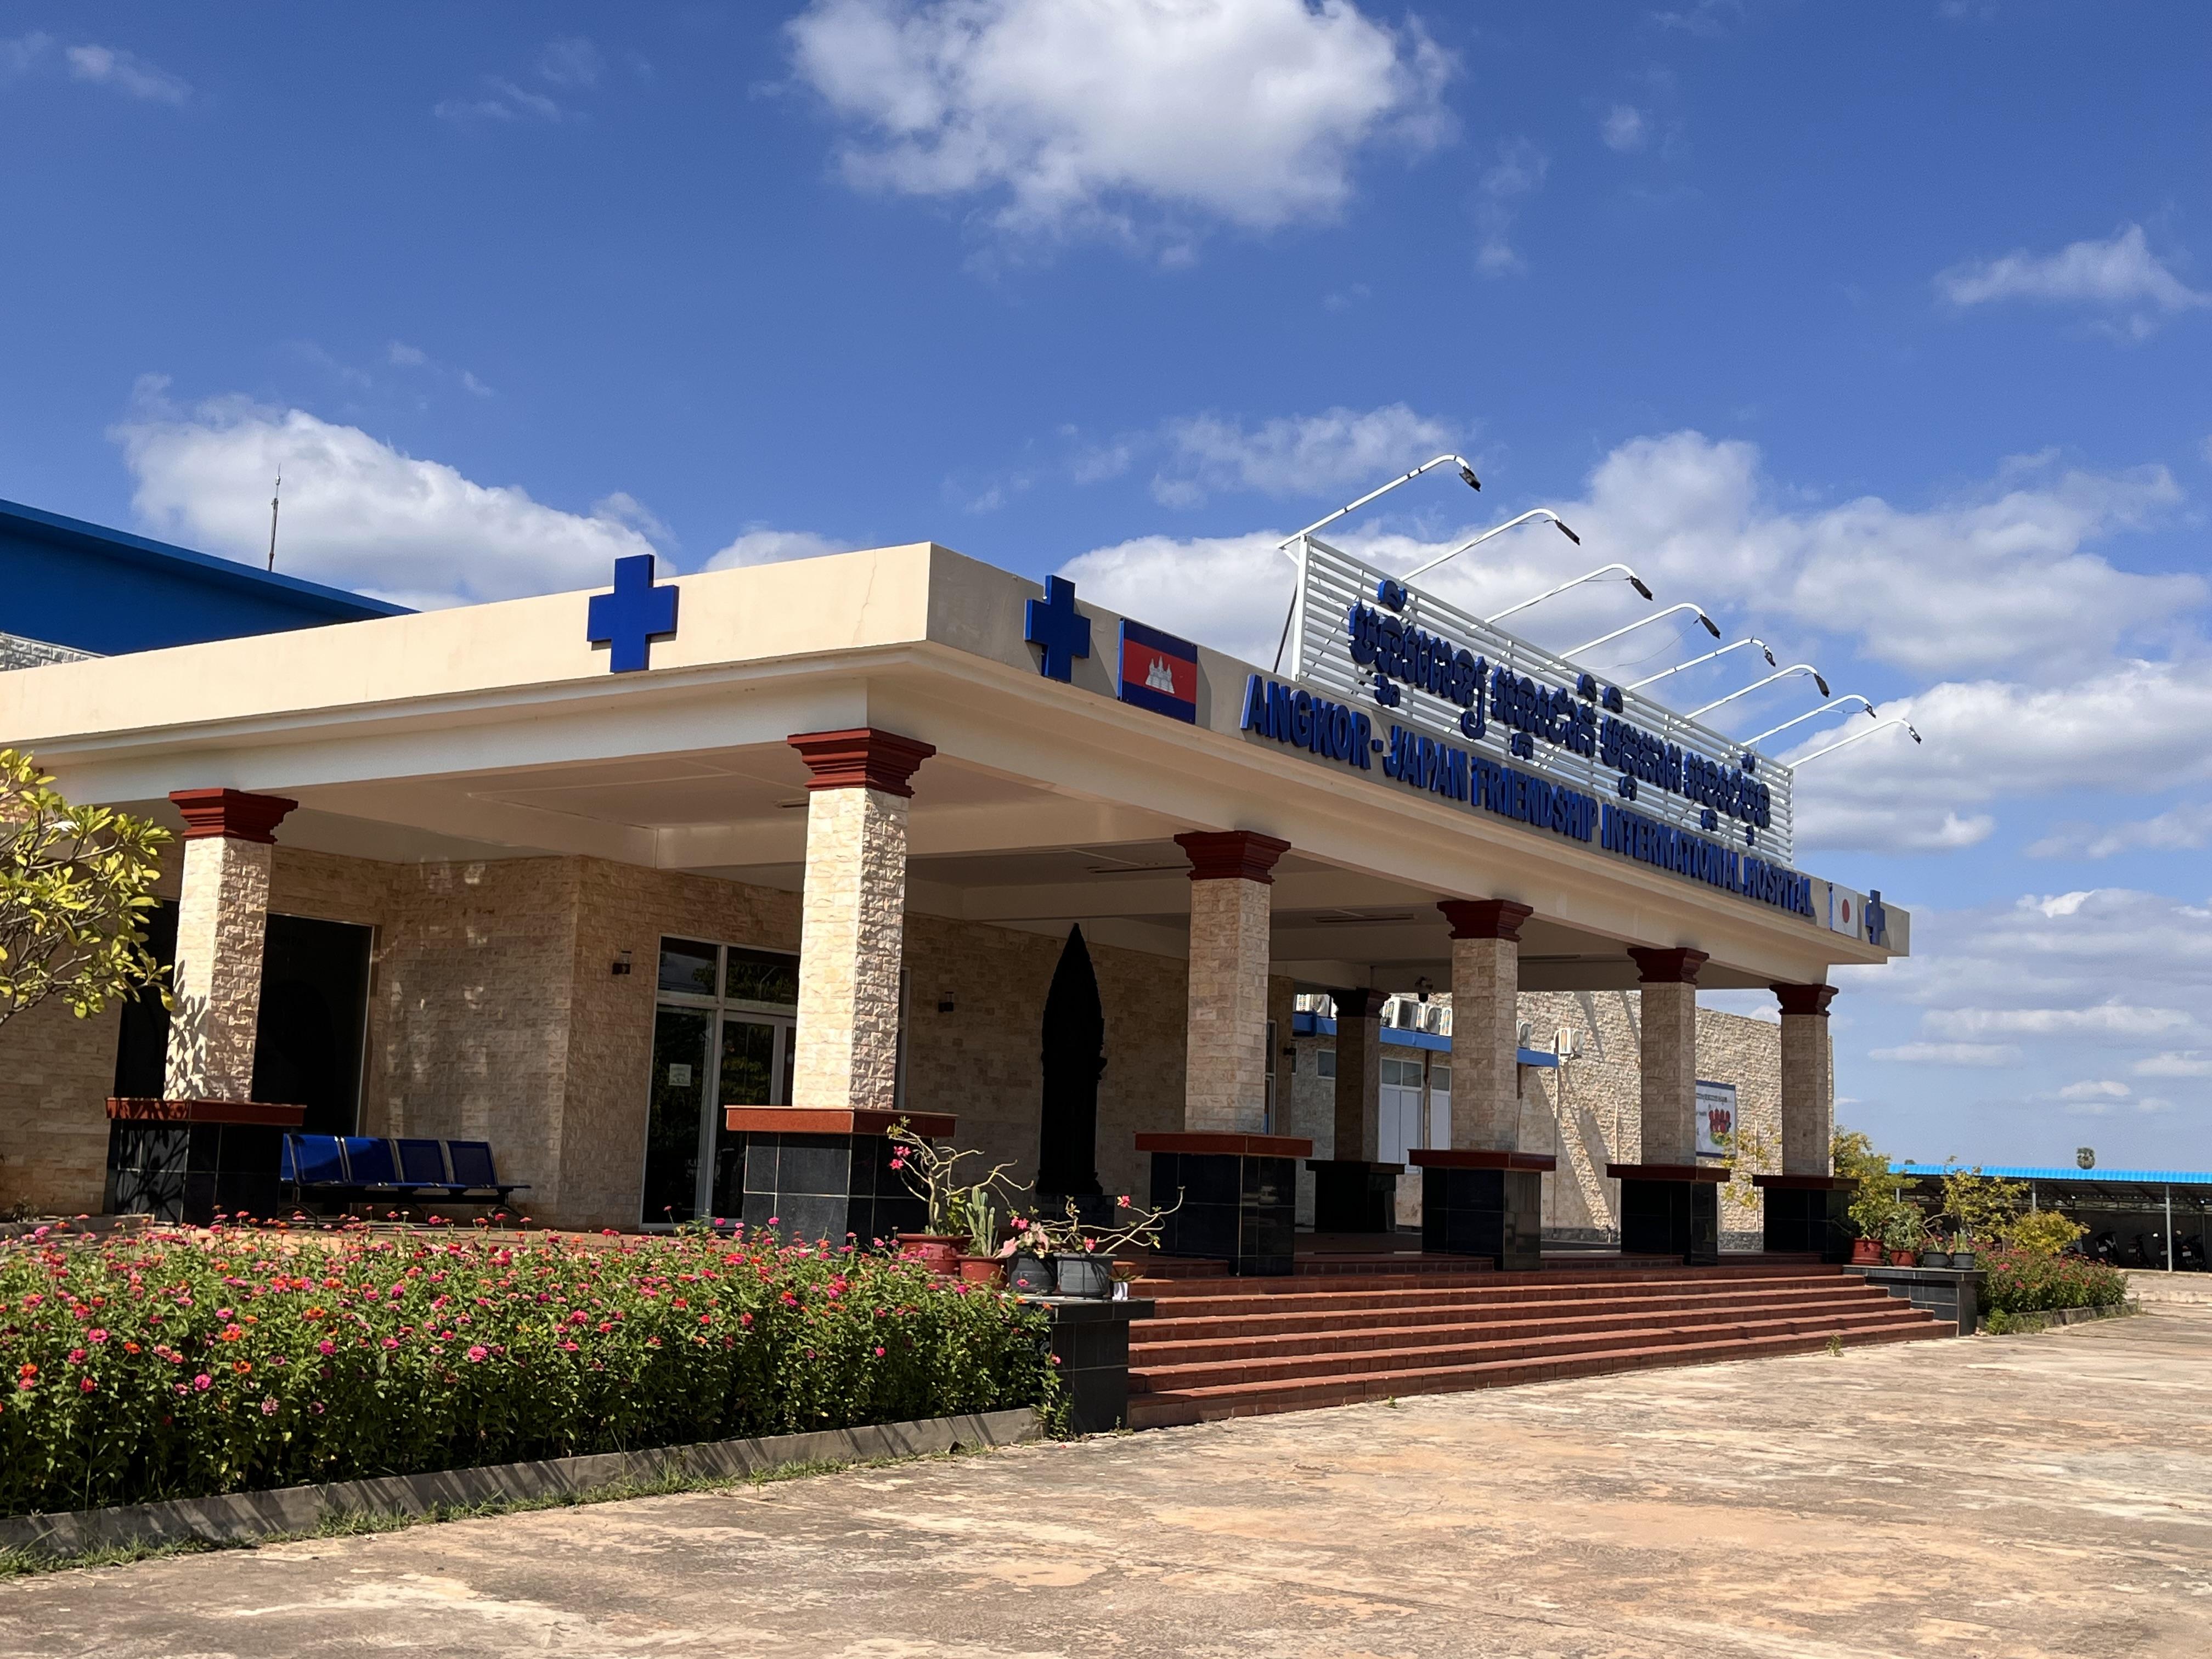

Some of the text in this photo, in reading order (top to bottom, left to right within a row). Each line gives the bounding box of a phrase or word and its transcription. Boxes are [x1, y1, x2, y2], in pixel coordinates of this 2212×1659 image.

[1470, 754, 1599, 843] FRIENDSHIP
[1601, 800, 1744, 894] INTERNATIONAL
[1743, 856, 1815, 917] HOSPITAL
